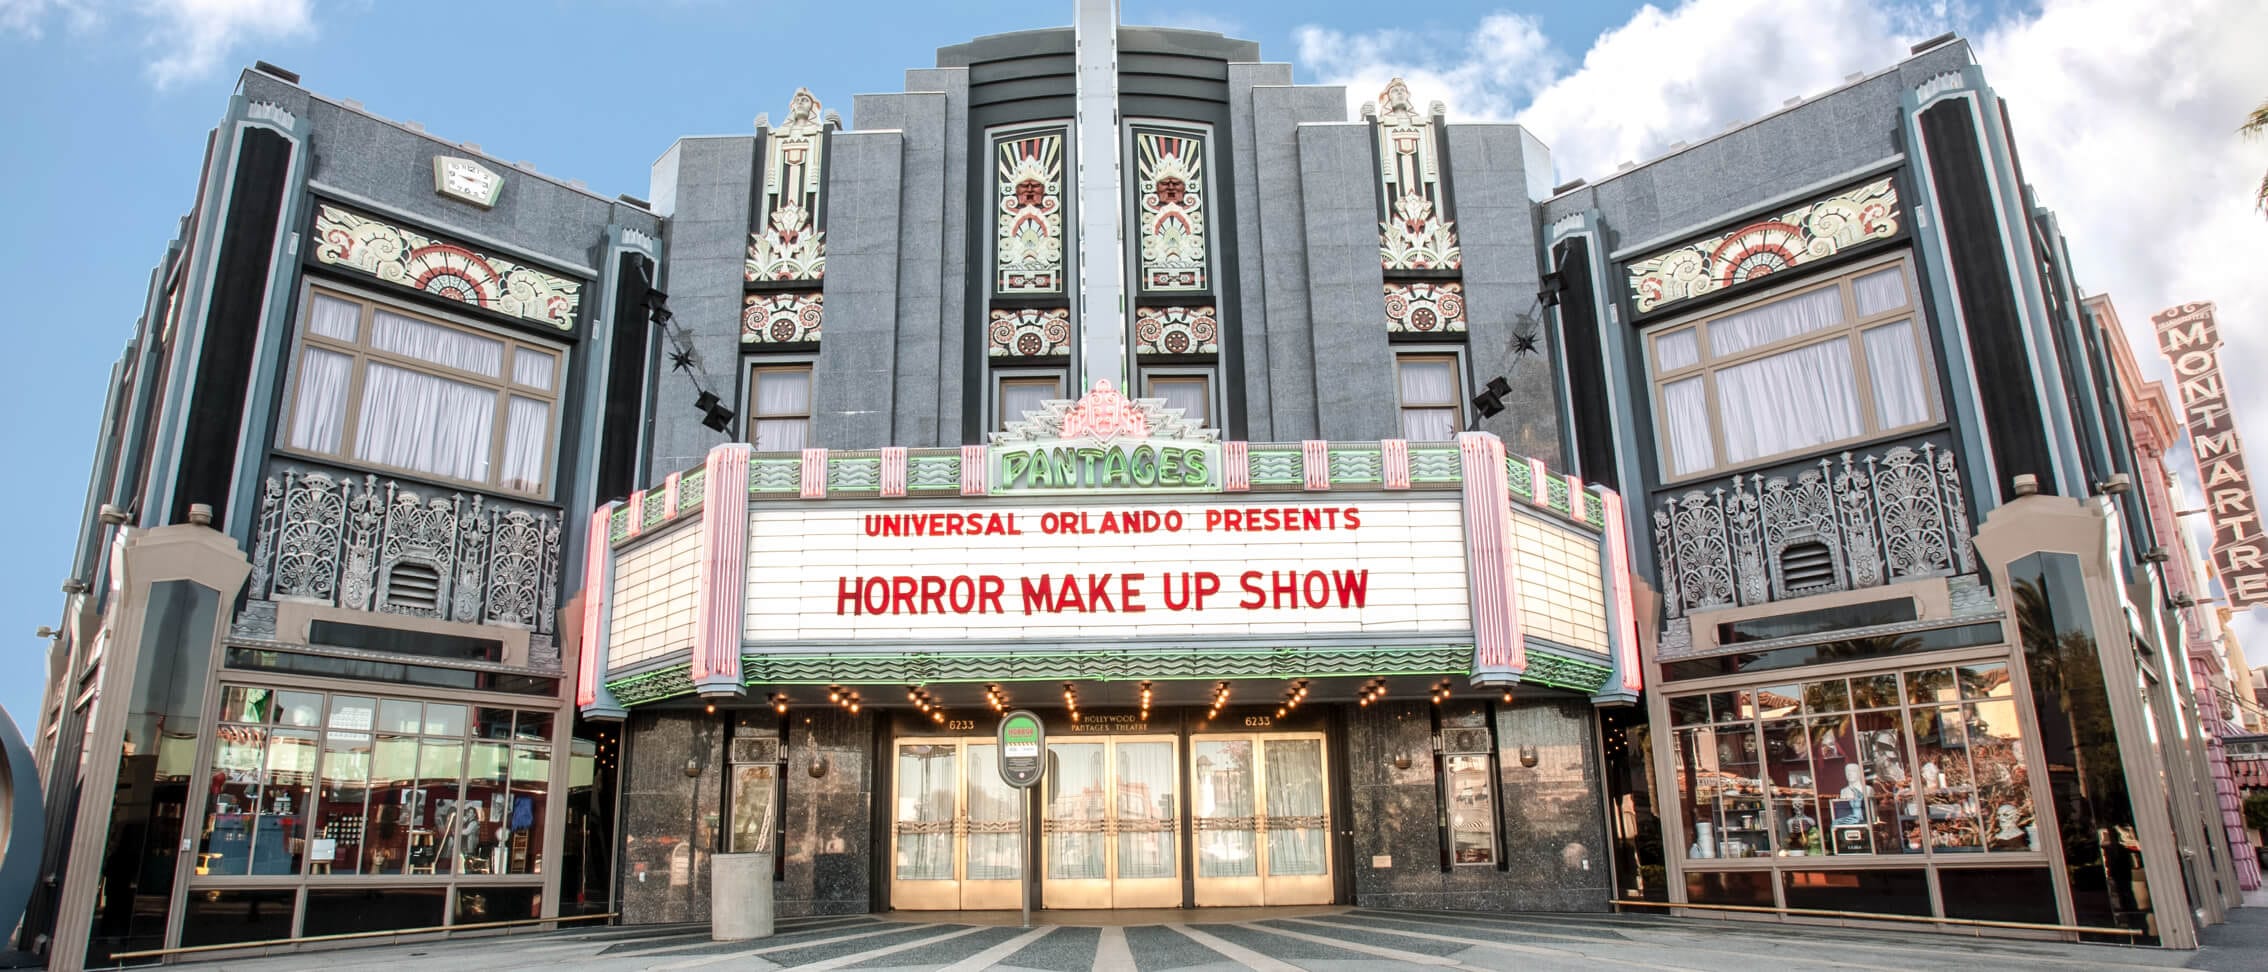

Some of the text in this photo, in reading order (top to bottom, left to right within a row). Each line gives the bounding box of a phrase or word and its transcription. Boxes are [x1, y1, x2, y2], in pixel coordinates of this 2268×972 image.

[1002, 445, 1209, 488] PANTAGES
[2168, 321, 2268, 600] MONTMARTRE
[864, 507, 1361, 539] UNIVERSAL ORLANDO PRESENTS
[836, 568, 1369, 617] HORROR MAKE UP SHOW
[949, 720, 975, 730] 6233
[1071, 724, 1109, 732] PANTAGES
[1245, 716, 1271, 726] 6233
